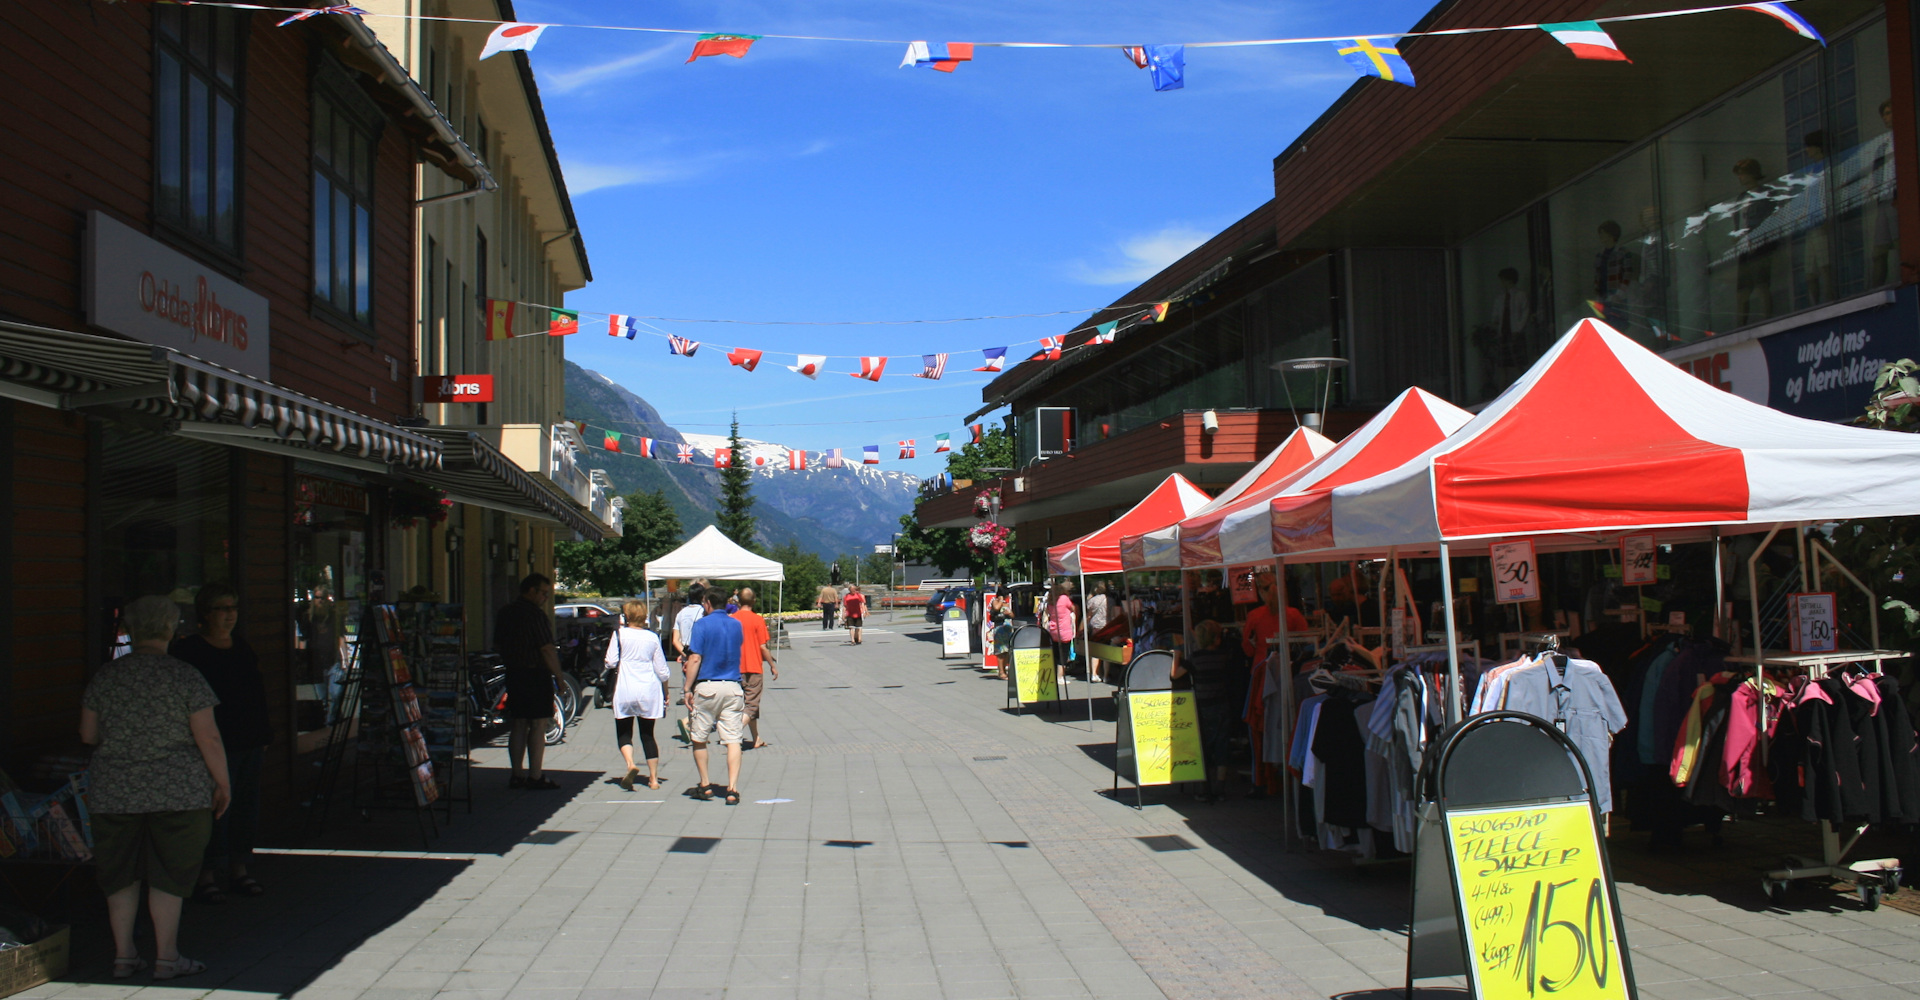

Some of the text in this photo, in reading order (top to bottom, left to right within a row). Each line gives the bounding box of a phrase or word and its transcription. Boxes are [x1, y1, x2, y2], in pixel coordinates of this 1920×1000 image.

[139, 270, 191, 327] Odda
[1785, 376, 1803, 404] og
[1459, 813, 1548, 837] SKOGSTAD
[1478, 848, 1580, 877] JAKKER
[1471, 881, 1500, 901] 4-14
